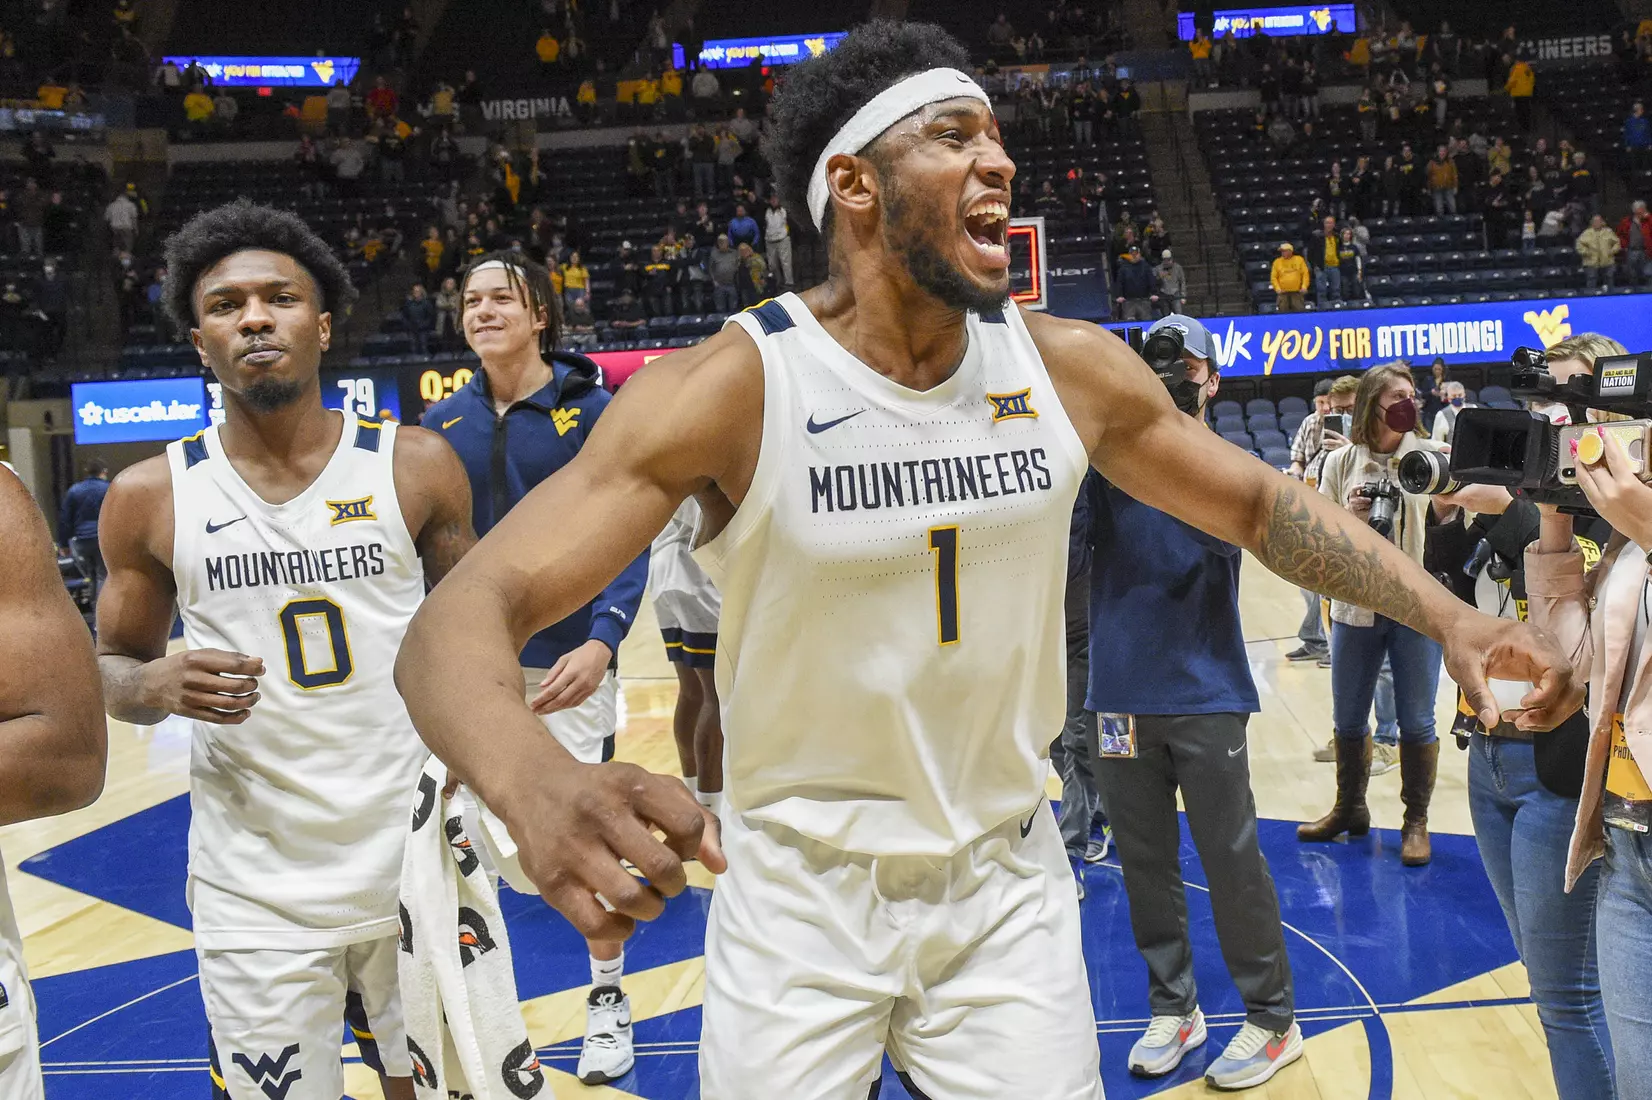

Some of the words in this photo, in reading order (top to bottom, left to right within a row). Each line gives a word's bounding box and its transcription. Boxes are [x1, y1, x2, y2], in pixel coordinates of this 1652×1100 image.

[1329, 327, 1371, 359] FOR
[1376, 320, 1503, 358] ATTENDING!
[1603, 376, 1633, 387] NATION
[988, 392, 1037, 421] XII
[808, 447, 1052, 514] MOUNTAINEERS
[328, 497, 376, 523] XII
[205, 543, 385, 591] MOUNTAINEERS
[927, 524, 961, 647] 1
[278, 597, 355, 691] 0
